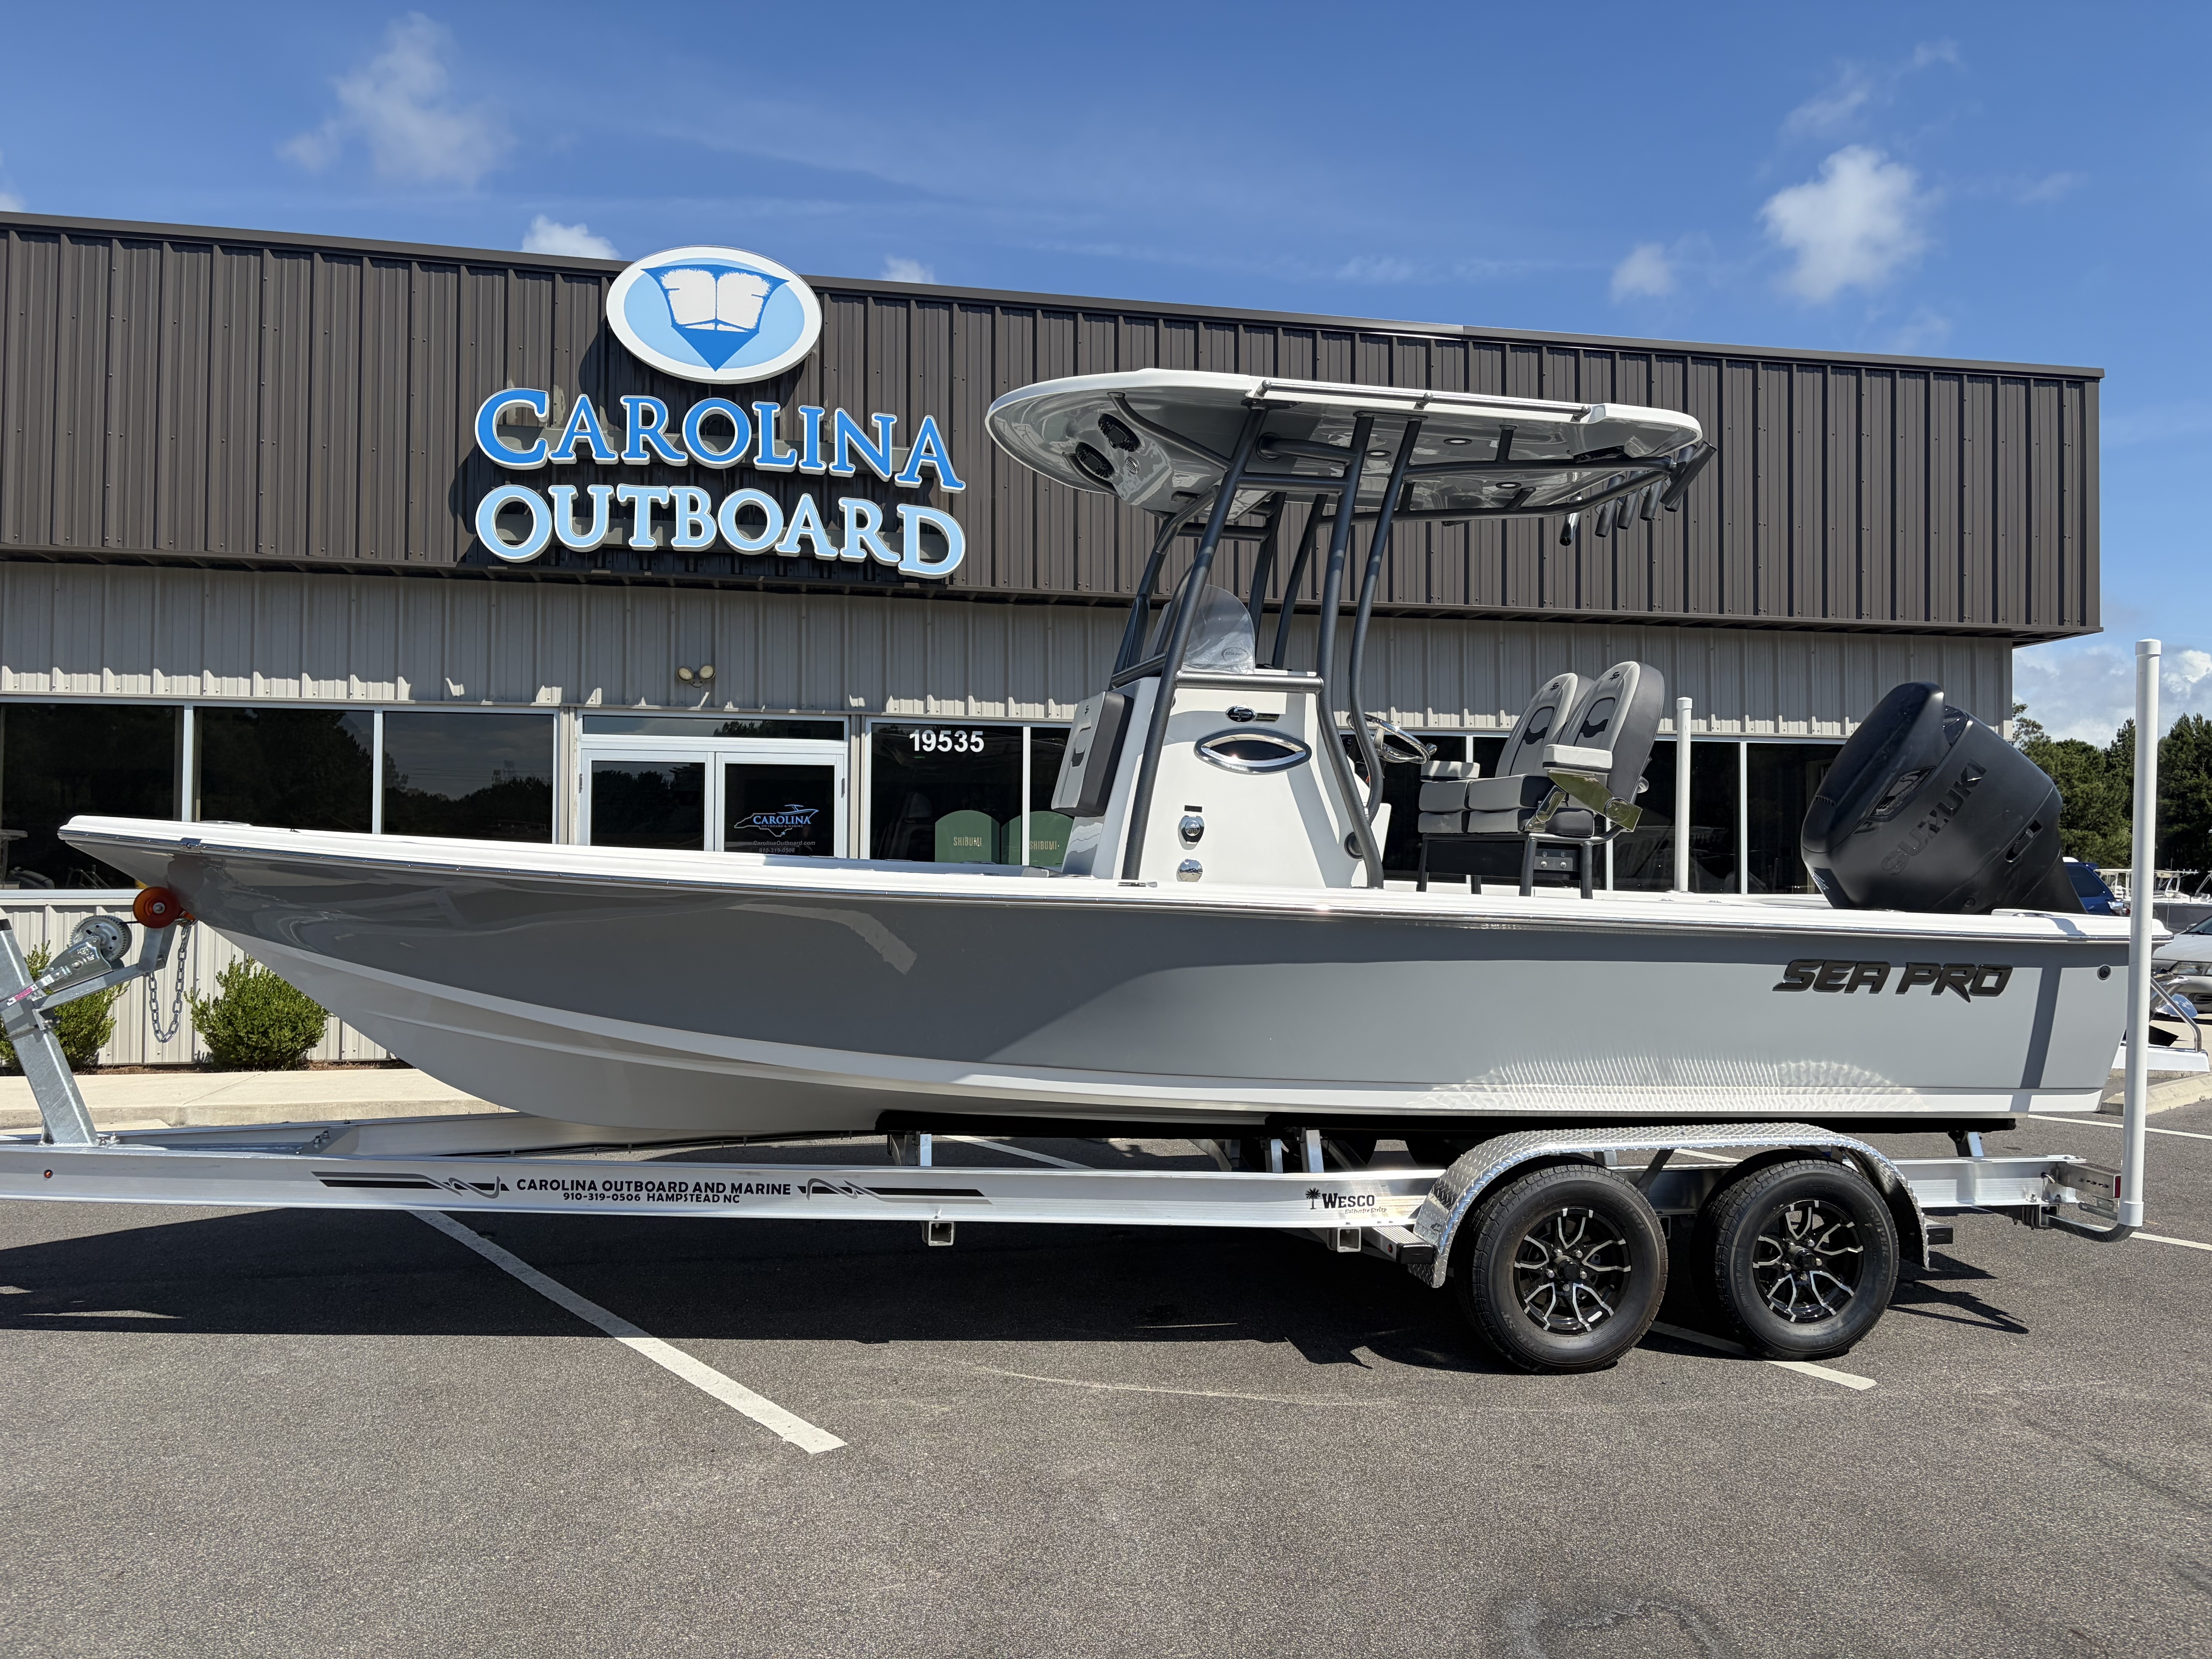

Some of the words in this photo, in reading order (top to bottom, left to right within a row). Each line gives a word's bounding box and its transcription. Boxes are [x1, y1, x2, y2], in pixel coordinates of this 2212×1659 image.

[475, 388, 966, 493] CAROLINA
[475, 483, 966, 579] OUTBOARD
[909, 729, 984, 752] 19535
[753, 816, 812, 824] CAROLINA
[1881, 758, 1987, 876] SUZUKI
[953, 837, 982, 846] SHIBUMI
[1029, 841, 1057, 850] SHIBUMI
[1772, 959, 1891, 994] SEA
[1895, 962, 2013, 1003] PRO
[517, 1179, 598, 1191] CAROLINA
[602, 1180, 689, 1193] OUTBOARD
[692, 1182, 726, 1194] AND
[731, 1183, 791, 1195] MARINE
[563, 1192, 641, 1201] 910-319-0506
[647, 1193, 720, 1203] HAMPSTEAD
[724, 1195, 740, 1203] NC
[1322, 1193, 1375, 1209] WESCO
